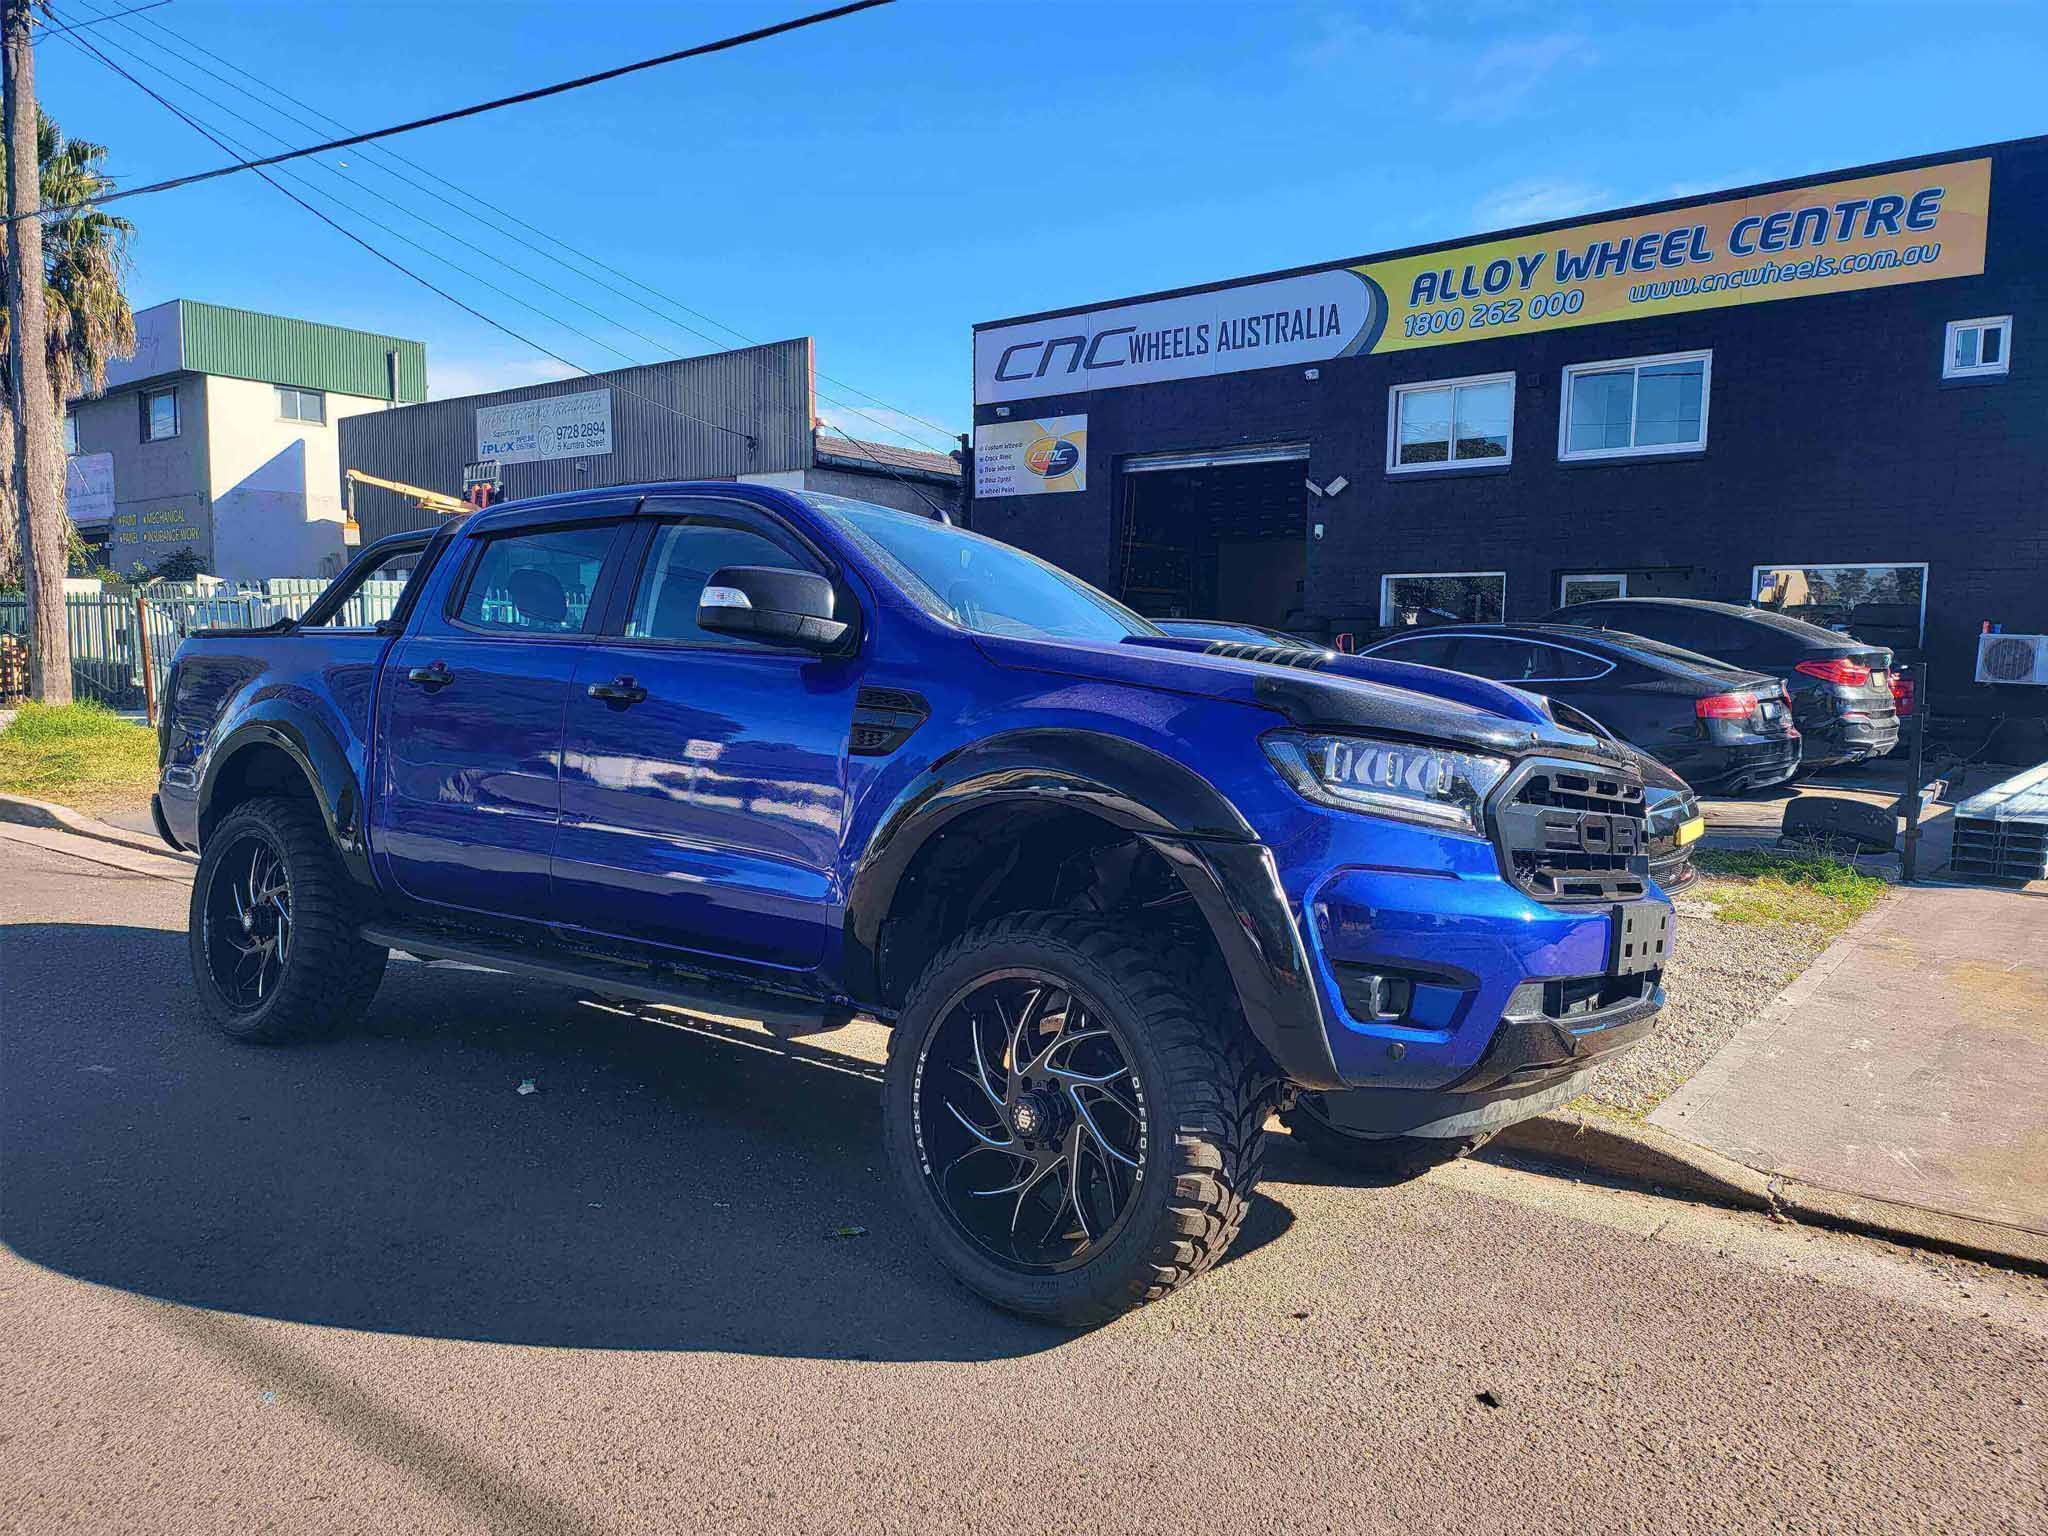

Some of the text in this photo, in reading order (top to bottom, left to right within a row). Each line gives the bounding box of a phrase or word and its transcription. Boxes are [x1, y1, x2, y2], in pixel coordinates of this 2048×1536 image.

[1408, 187, 1946, 307] ALLOY WHEEL CENTRE
[1628, 242, 1942, 302] www.cncwheels.com.au
[1128, 324, 1210, 365] WHEELS
[1217, 303, 1341, 353] AUSTRALIA
[1404, 289, 1585, 338] 1800 262 000
[556, 424, 579, 441] 9728
[580, 421, 605, 438] 2894
